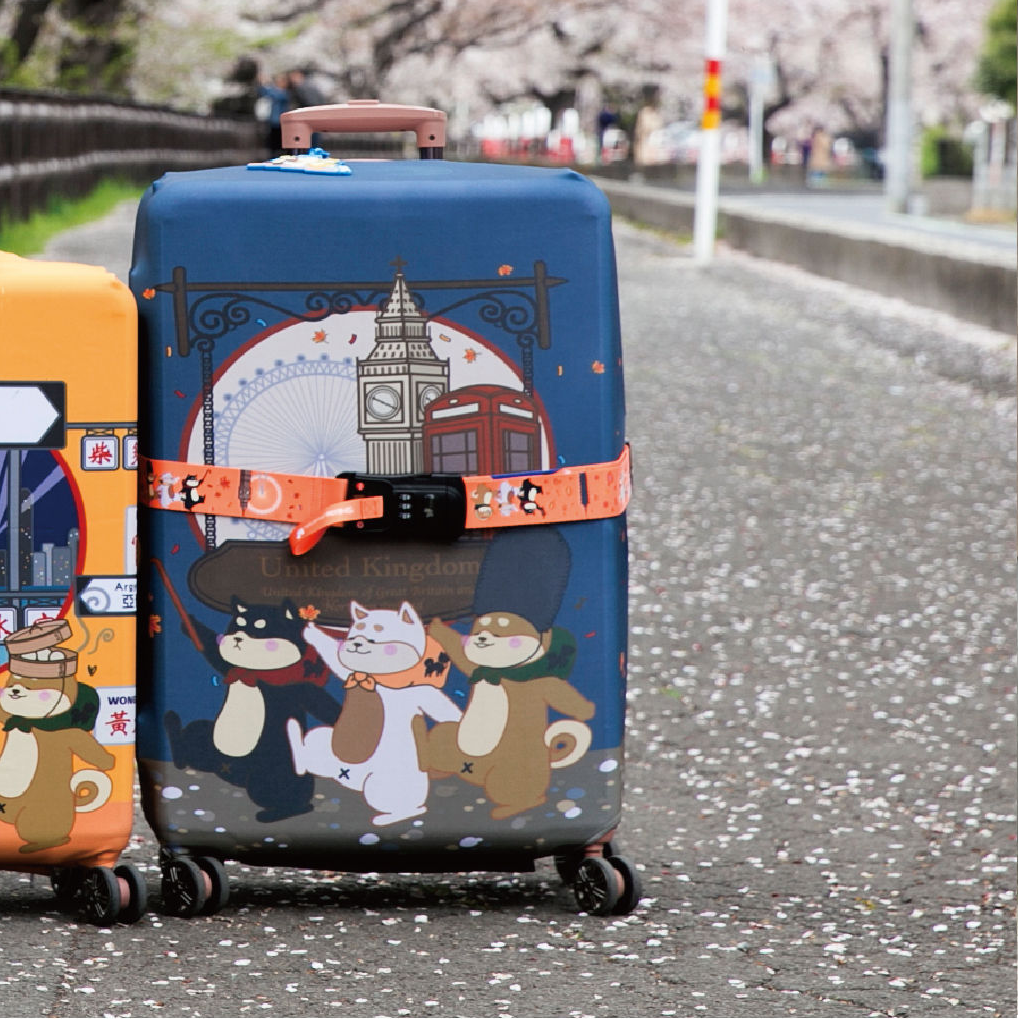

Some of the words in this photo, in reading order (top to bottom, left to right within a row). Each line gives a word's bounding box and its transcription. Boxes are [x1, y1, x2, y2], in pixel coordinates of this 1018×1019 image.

[88, 441, 113, 465] 柴
[260, 554, 351, 578] United
[362, 553, 480, 582] Kingdom
[104, 710, 136, 737] 黃
